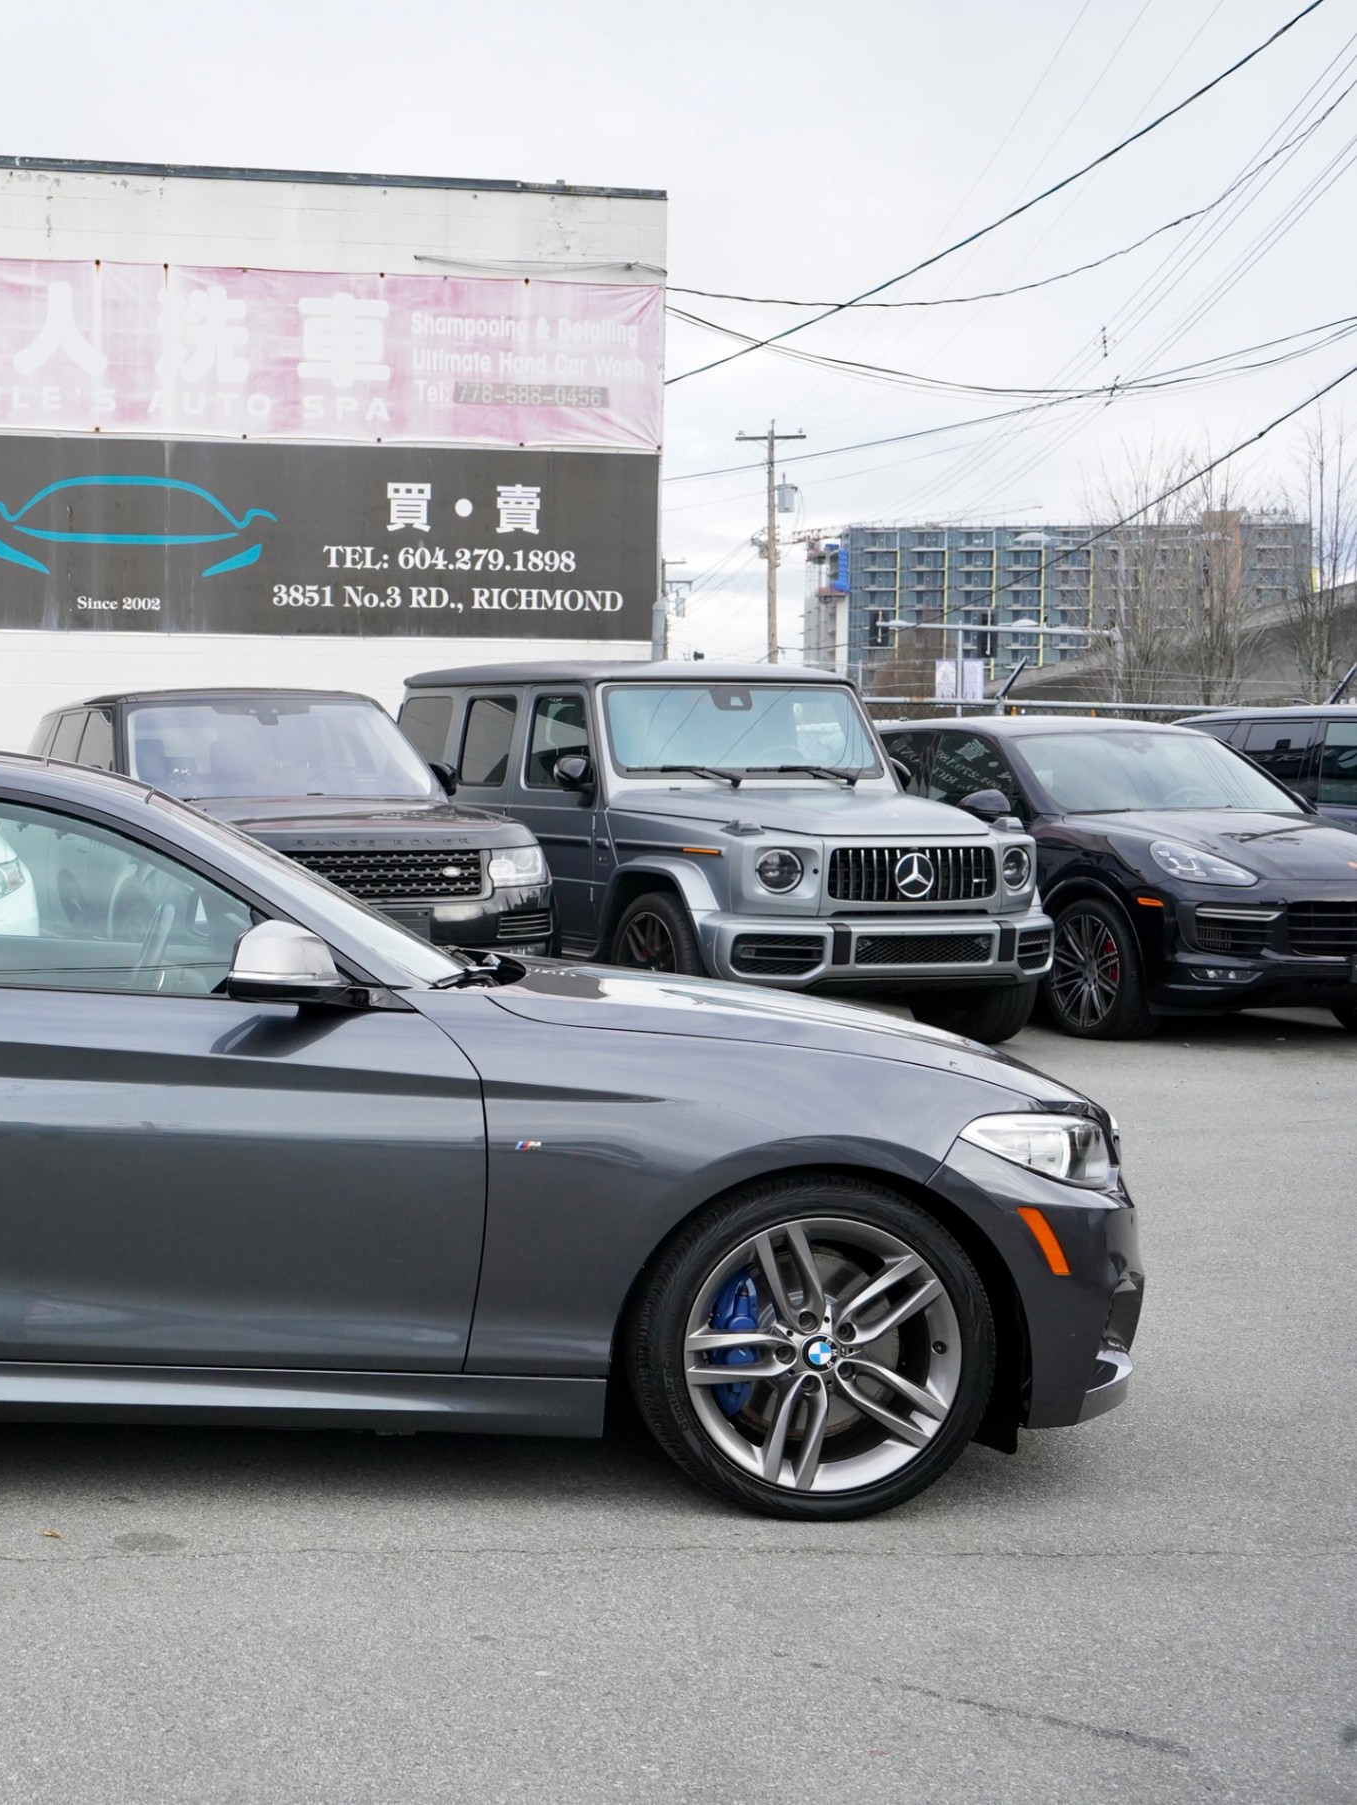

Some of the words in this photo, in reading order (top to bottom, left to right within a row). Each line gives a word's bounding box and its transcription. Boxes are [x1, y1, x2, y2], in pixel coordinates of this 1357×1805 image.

[411, 311, 528, 342] Shampooing
[535, 316, 551, 340] &
[557, 317, 639, 346] Detailing
[412, 349, 492, 373] Ultimate
[499, 351, 546, 375] Hand
[554, 354, 587, 376] Car
[594, 355, 645, 379] Wash
[148, 389, 273, 418] AUTO
[302, 395, 391, 422] SPA
[414, 380, 450, 403] Tel:
[458, 383, 603, 407] 778-588-0456
[322, 545, 389, 570] TEL:
[398, 546, 576, 573] 604.279.1898
[77, 595, 118, 610] Since
[122, 597, 161, 611] 2002
[272, 584, 335, 607] 3851
[343, 586, 402, 608] No.3
[409, 586, 463, 613] RD.,
[471, 587, 624, 612] RICHMOND
